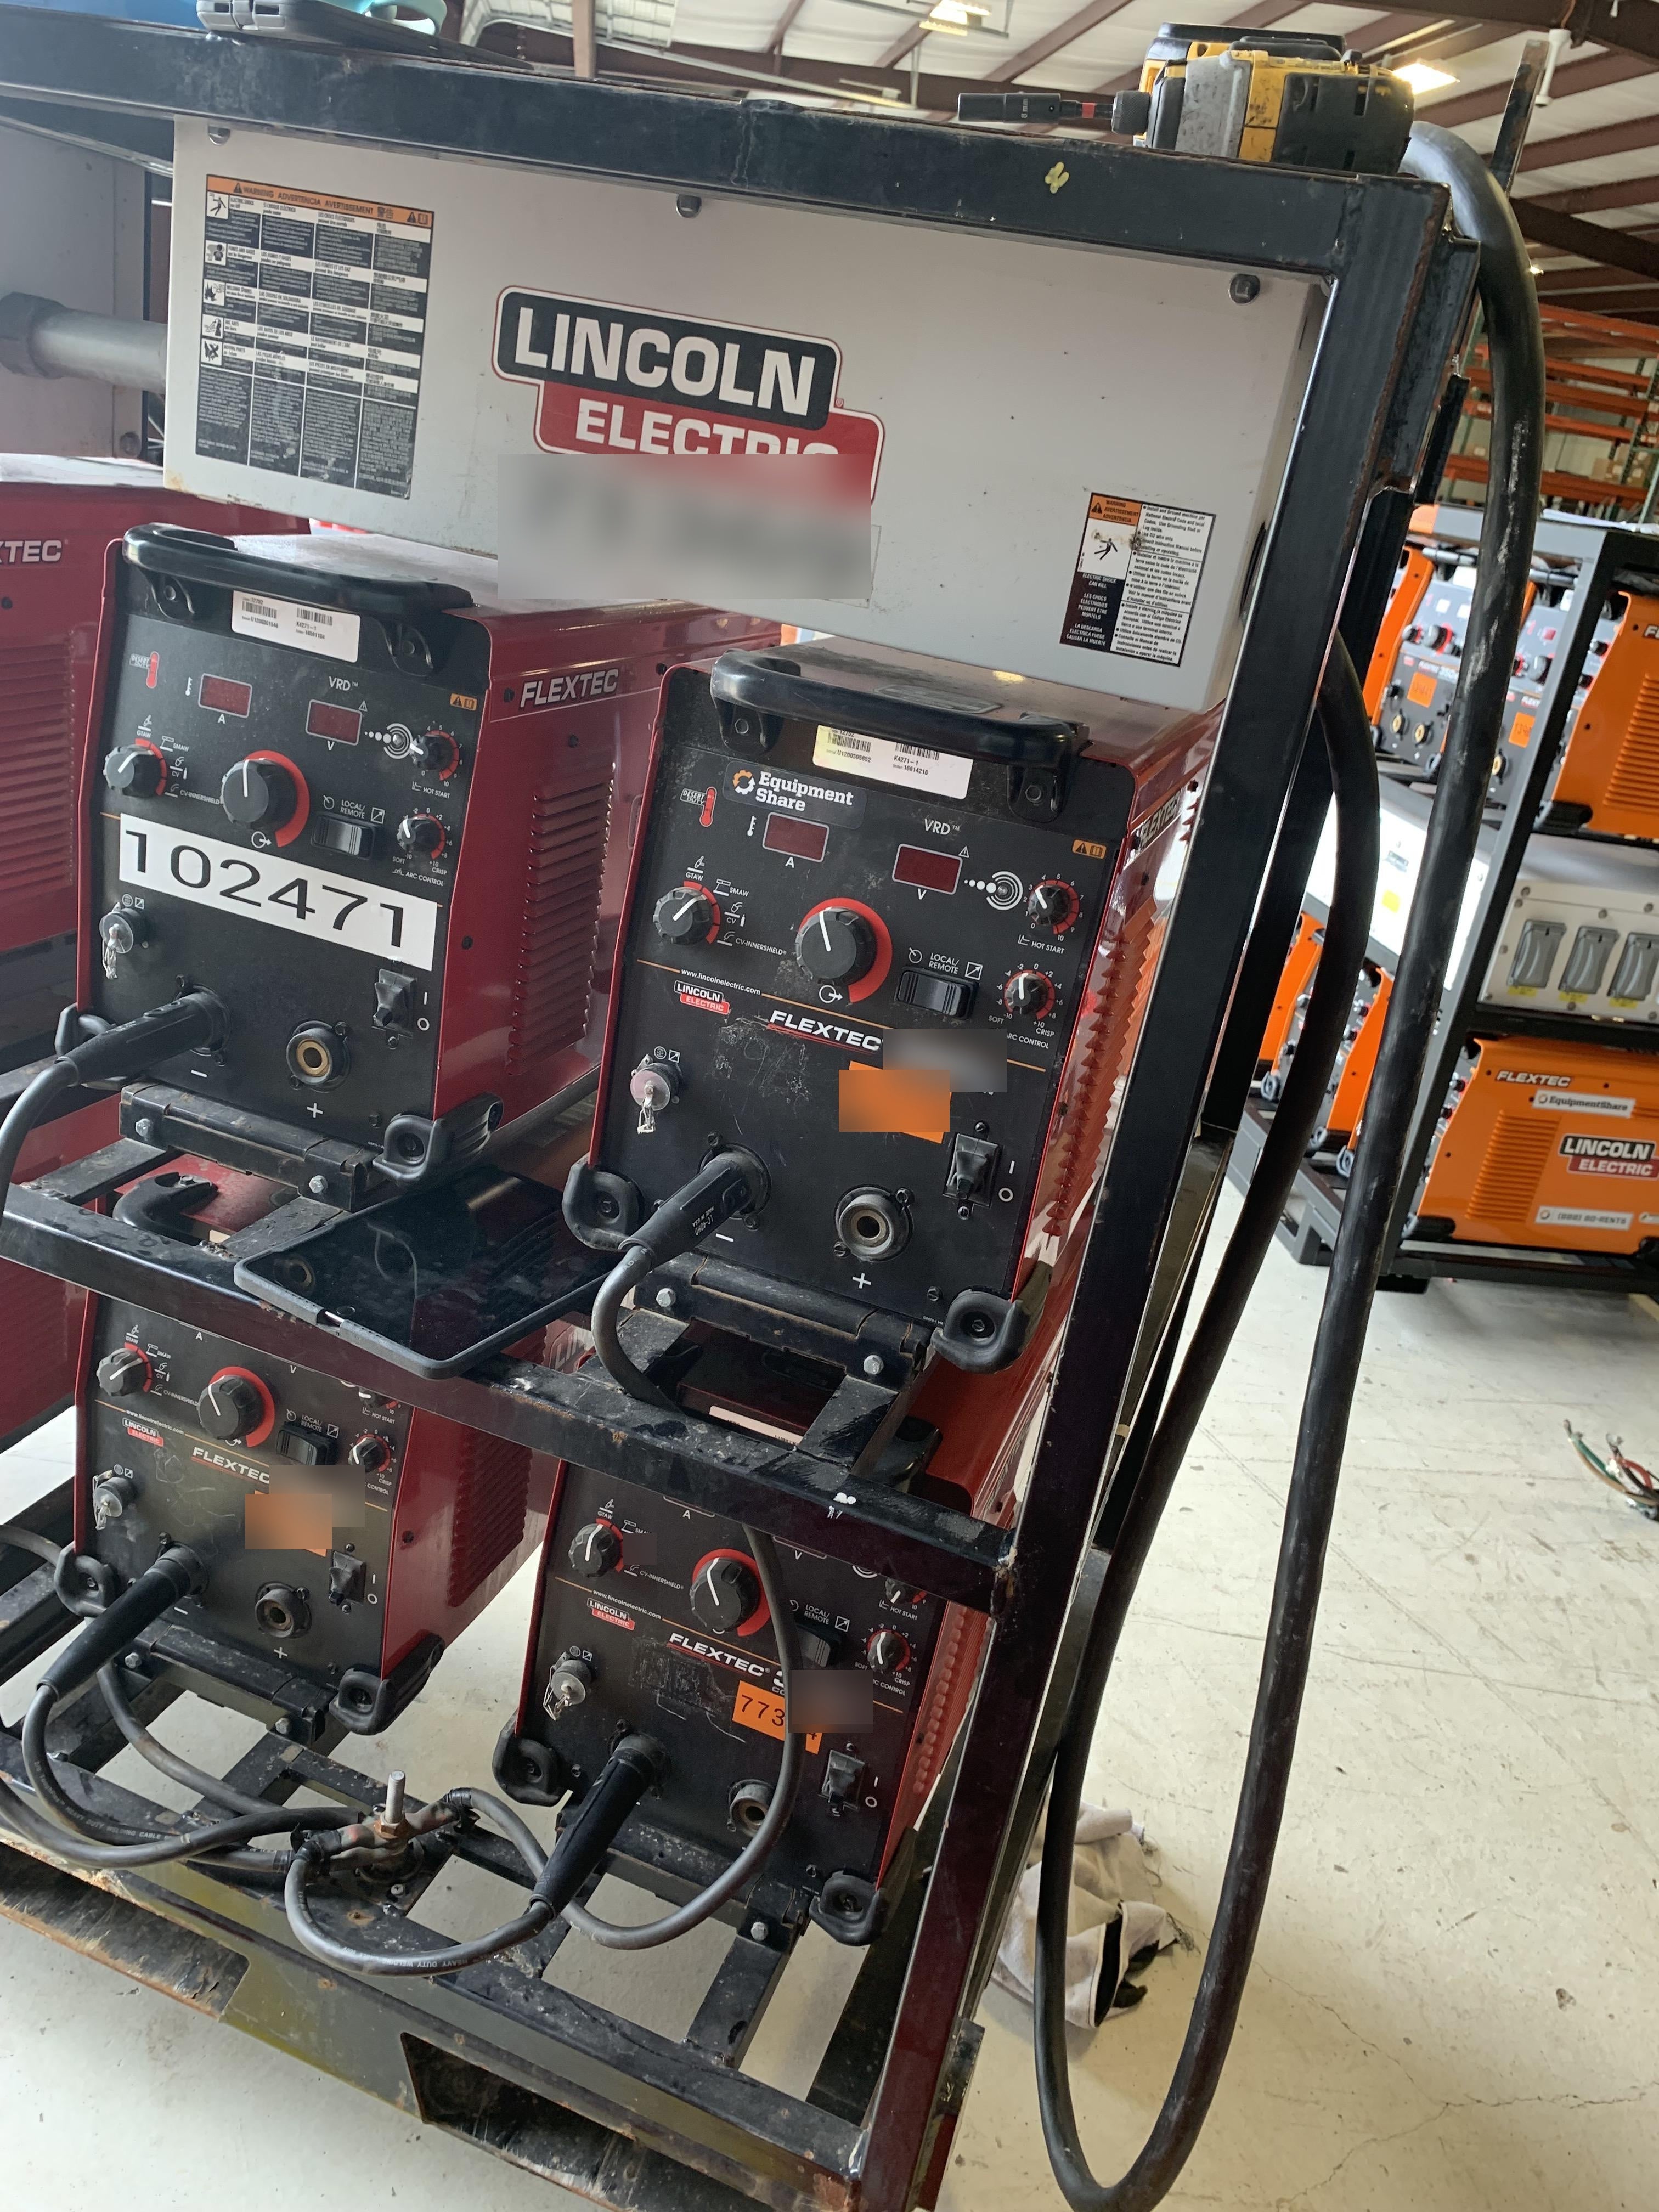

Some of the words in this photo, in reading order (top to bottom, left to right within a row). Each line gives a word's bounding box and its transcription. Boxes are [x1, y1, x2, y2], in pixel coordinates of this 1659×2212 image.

[514, 307, 816, 416] LINCOLN
[520, 669, 619, 708] FLEXTEC
[218, 713, 225, 724] A
[137, 730, 151, 738] GTAW
[173, 742, 189, 752] SMAW
[327, 740, 335, 751] V
[435, 790, 450, 799] START
[682, 789, 706, 799] DESERT
[758, 771, 854, 806] Equipment
[755, 787, 806, 812] Share
[340, 807, 365, 819] REMOTE
[785, 857, 794, 868] A
[432, 867, 447, 876] CRISP
[685, 872, 704, 881] GTAW
[418, 874, 444, 886] CONTROL
[125, 830, 404, 947] 102471
[730, 887, 749, 897] SMAW
[918, 888, 927, 900] V
[1031, 941, 1045, 949] HOT
[1046, 944, 1065, 954] START
[930, 952, 960, 966] LOCAL/
[928, 961, 959, 974] REMOTE
[681, 969, 760, 995] www.lincolnelectric.com
[676, 984, 720, 1002] LINCOLN
[685, 996, 724, 1012] ELECTRIC
[988, 1015, 1005, 1024] SOFT
[770, 1010, 882, 1051] FLEXTEC
[1035, 1028, 1055, 1037] CRISP
[1019, 1036, 1049, 1049] CONTROL
[1497, 1070, 1571, 1087] FLEXTEC
[1564, 1138, 1651, 1160] LINCOLN
[1578, 1158, 1654, 1176] ELECTRIC
[195, 1332, 202, 1341] A
[290, 1364, 297, 1374] V
[381, 1415, 395, 1424] START
[125, 1420, 156, 1437] LINCOLN
[193, 1447, 269, 1484] FLEXTEC
[367, 1483, 389, 1496] CONTROL
[597, 1510, 613, 1520] GTAW
[682, 1510, 691, 1520] A
[795, 1550, 802, 1560] V
[589, 1600, 627, 1620] LINCOLN
[593, 1589, 661, 1620] www.lincolnelectric.com
[805, 1604, 830, 1618] LOCAL/
[597, 1610, 630, 1628] ELECTRIC
[804, 1610, 830, 1625] REMOTE
[890, 1607, 901, 1615] HOT
[901, 1610, 917, 1621] START
[880, 1681, 906, 1696] CONTROL
[894, 1678, 910, 1686] CRISP
